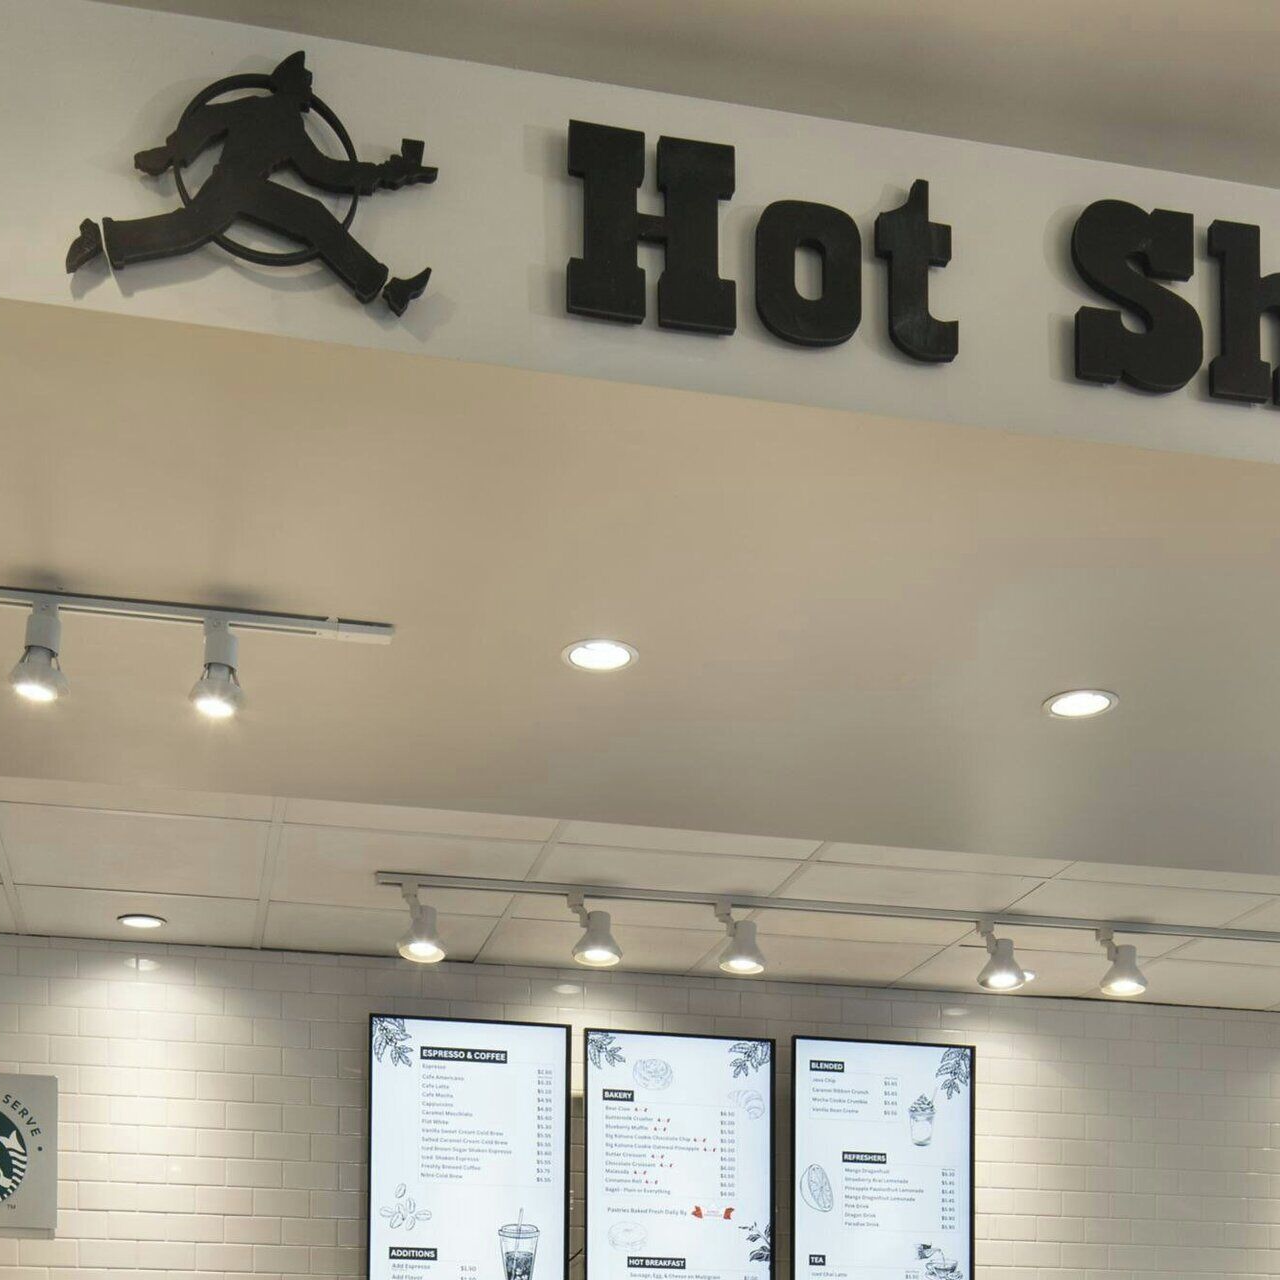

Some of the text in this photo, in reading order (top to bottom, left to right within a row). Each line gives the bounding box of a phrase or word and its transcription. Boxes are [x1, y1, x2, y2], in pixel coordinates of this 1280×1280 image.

[563, 117, 959, 364] Hot
[422, 1049, 465, 1060] ESPRESSO
[473, 1051, 506, 1061] COFFEE
[811, 1062, 843, 1070] BLENDED
[604, 1091, 632, 1100] BAKERY
[2, 1094, 42, 1137] SERVE
[843, 1153, 886, 1162] REFRESHERS
[390, 1249, 436, 1258] ADDITIONS
[629, 1258, 685, 1268] HOT BREAKFAST
[810, 1256, 824, 1264] TEA
